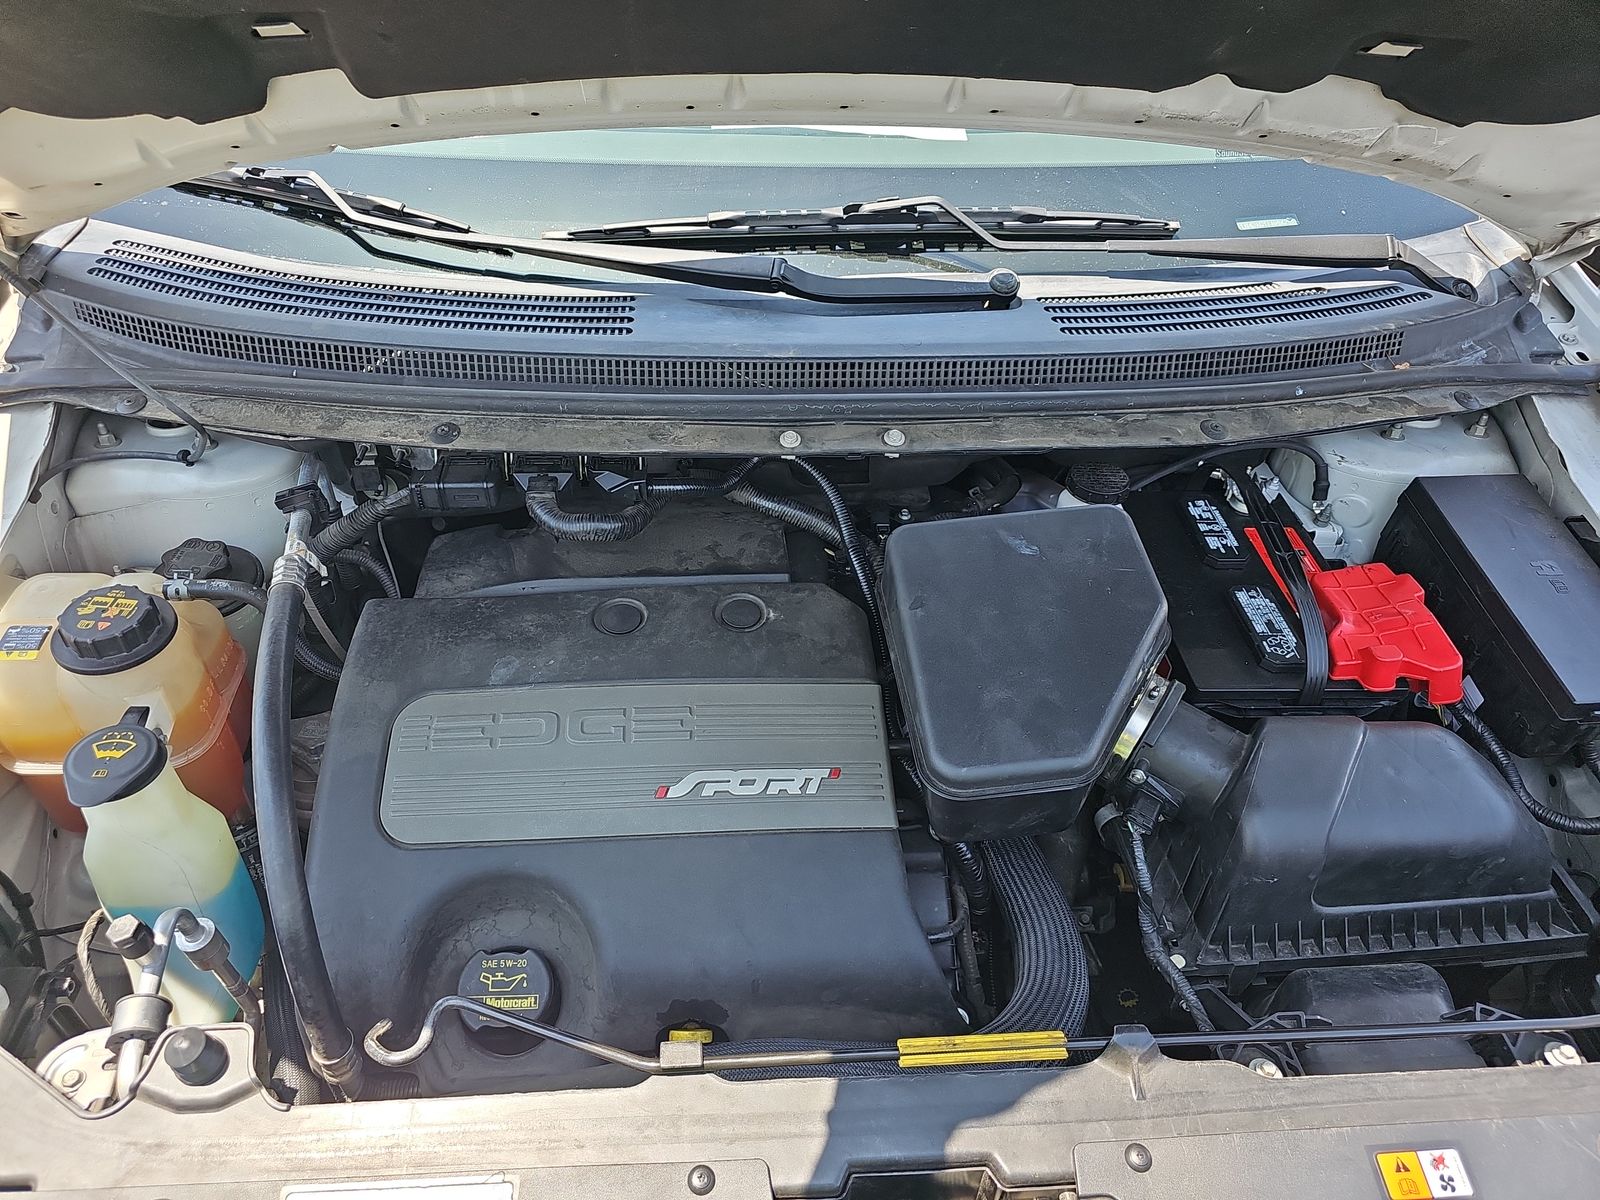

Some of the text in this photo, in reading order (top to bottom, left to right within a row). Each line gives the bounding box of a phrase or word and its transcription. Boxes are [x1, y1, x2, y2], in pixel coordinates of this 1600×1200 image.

[430, 705, 693, 750] EDGE
[666, 768, 831, 799] SPORT
[481, 959, 528, 969] SAE 5W-20
[485, 996, 537, 1008] Motorcraft
